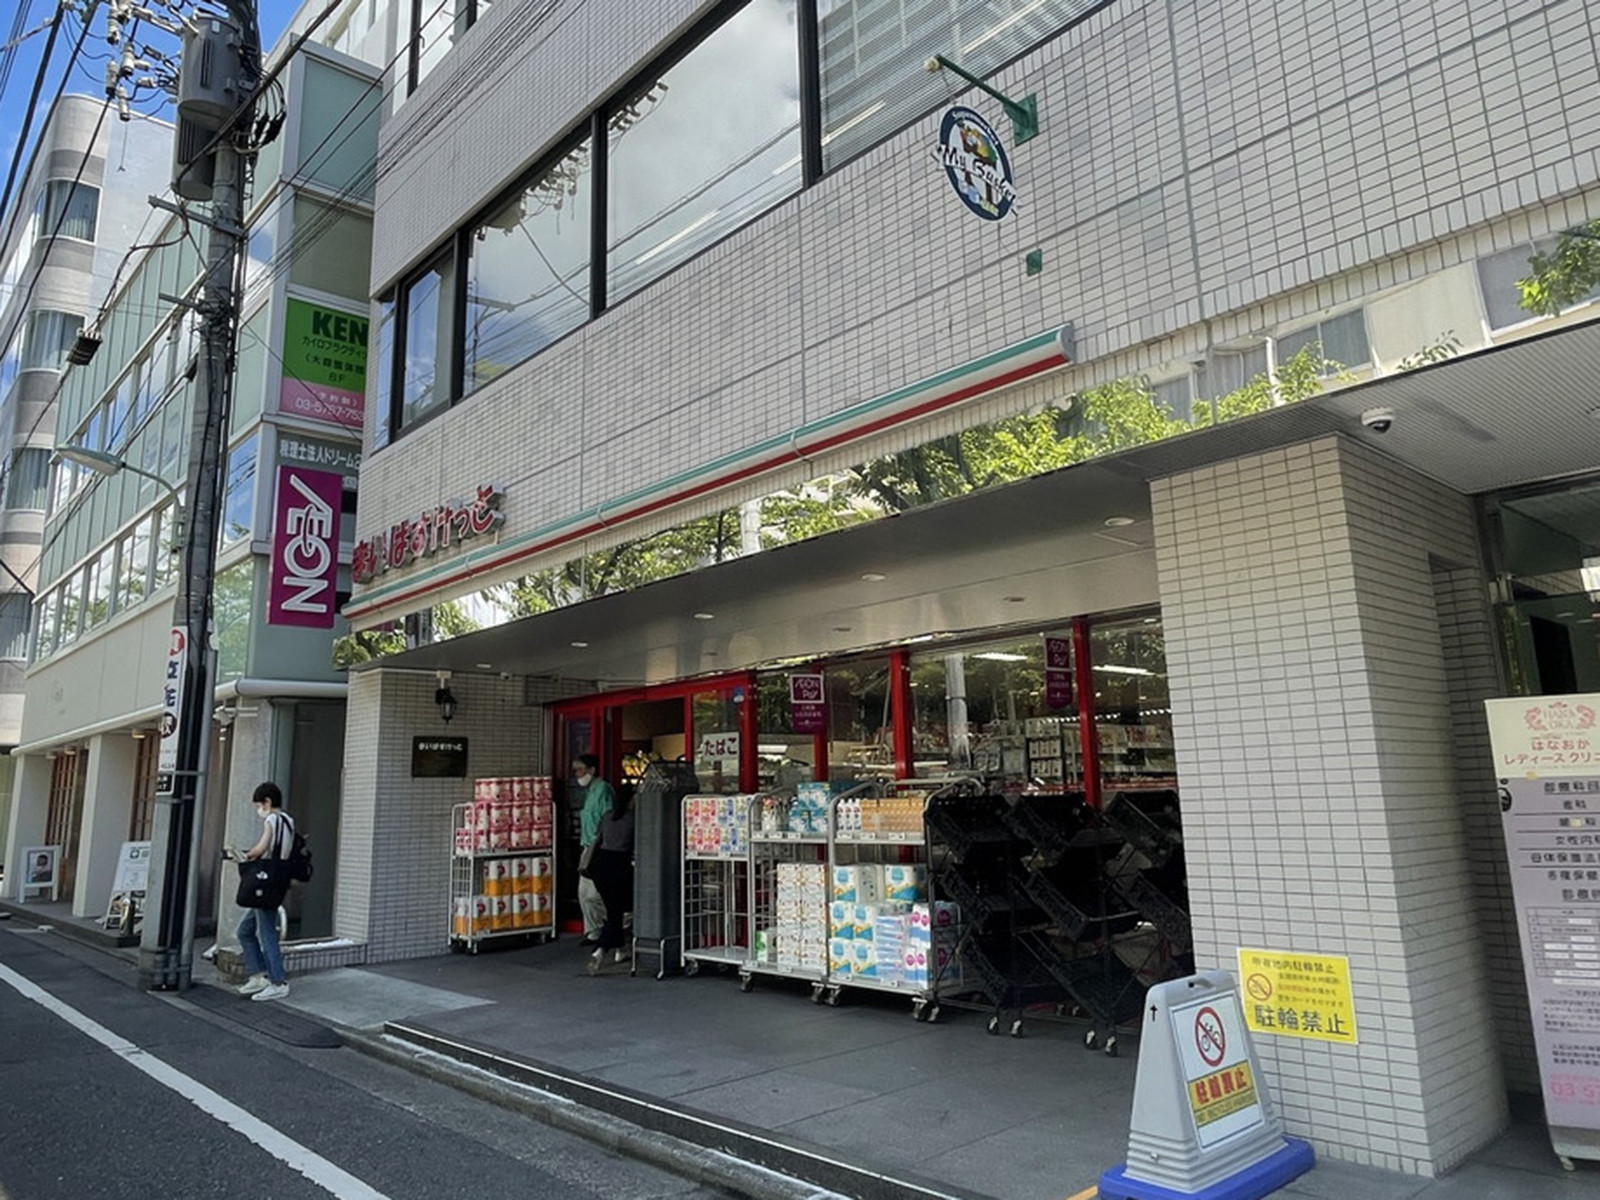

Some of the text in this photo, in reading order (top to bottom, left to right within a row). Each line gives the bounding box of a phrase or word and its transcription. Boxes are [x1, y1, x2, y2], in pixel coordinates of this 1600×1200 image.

[312, 310, 368, 346] KEN
[281, 474, 333, 614] AEON
[352, 484, 495, 584] まいばすけっと
[794, 678, 820, 689] AEON
[704, 737, 737, 756] たばこ
[1531, 737, 1590, 751] はなおか
[1255, 1005, 1350, 1035] 駐輪禁止
[1196, 1067, 1247, 1105] 駐輪禁止
